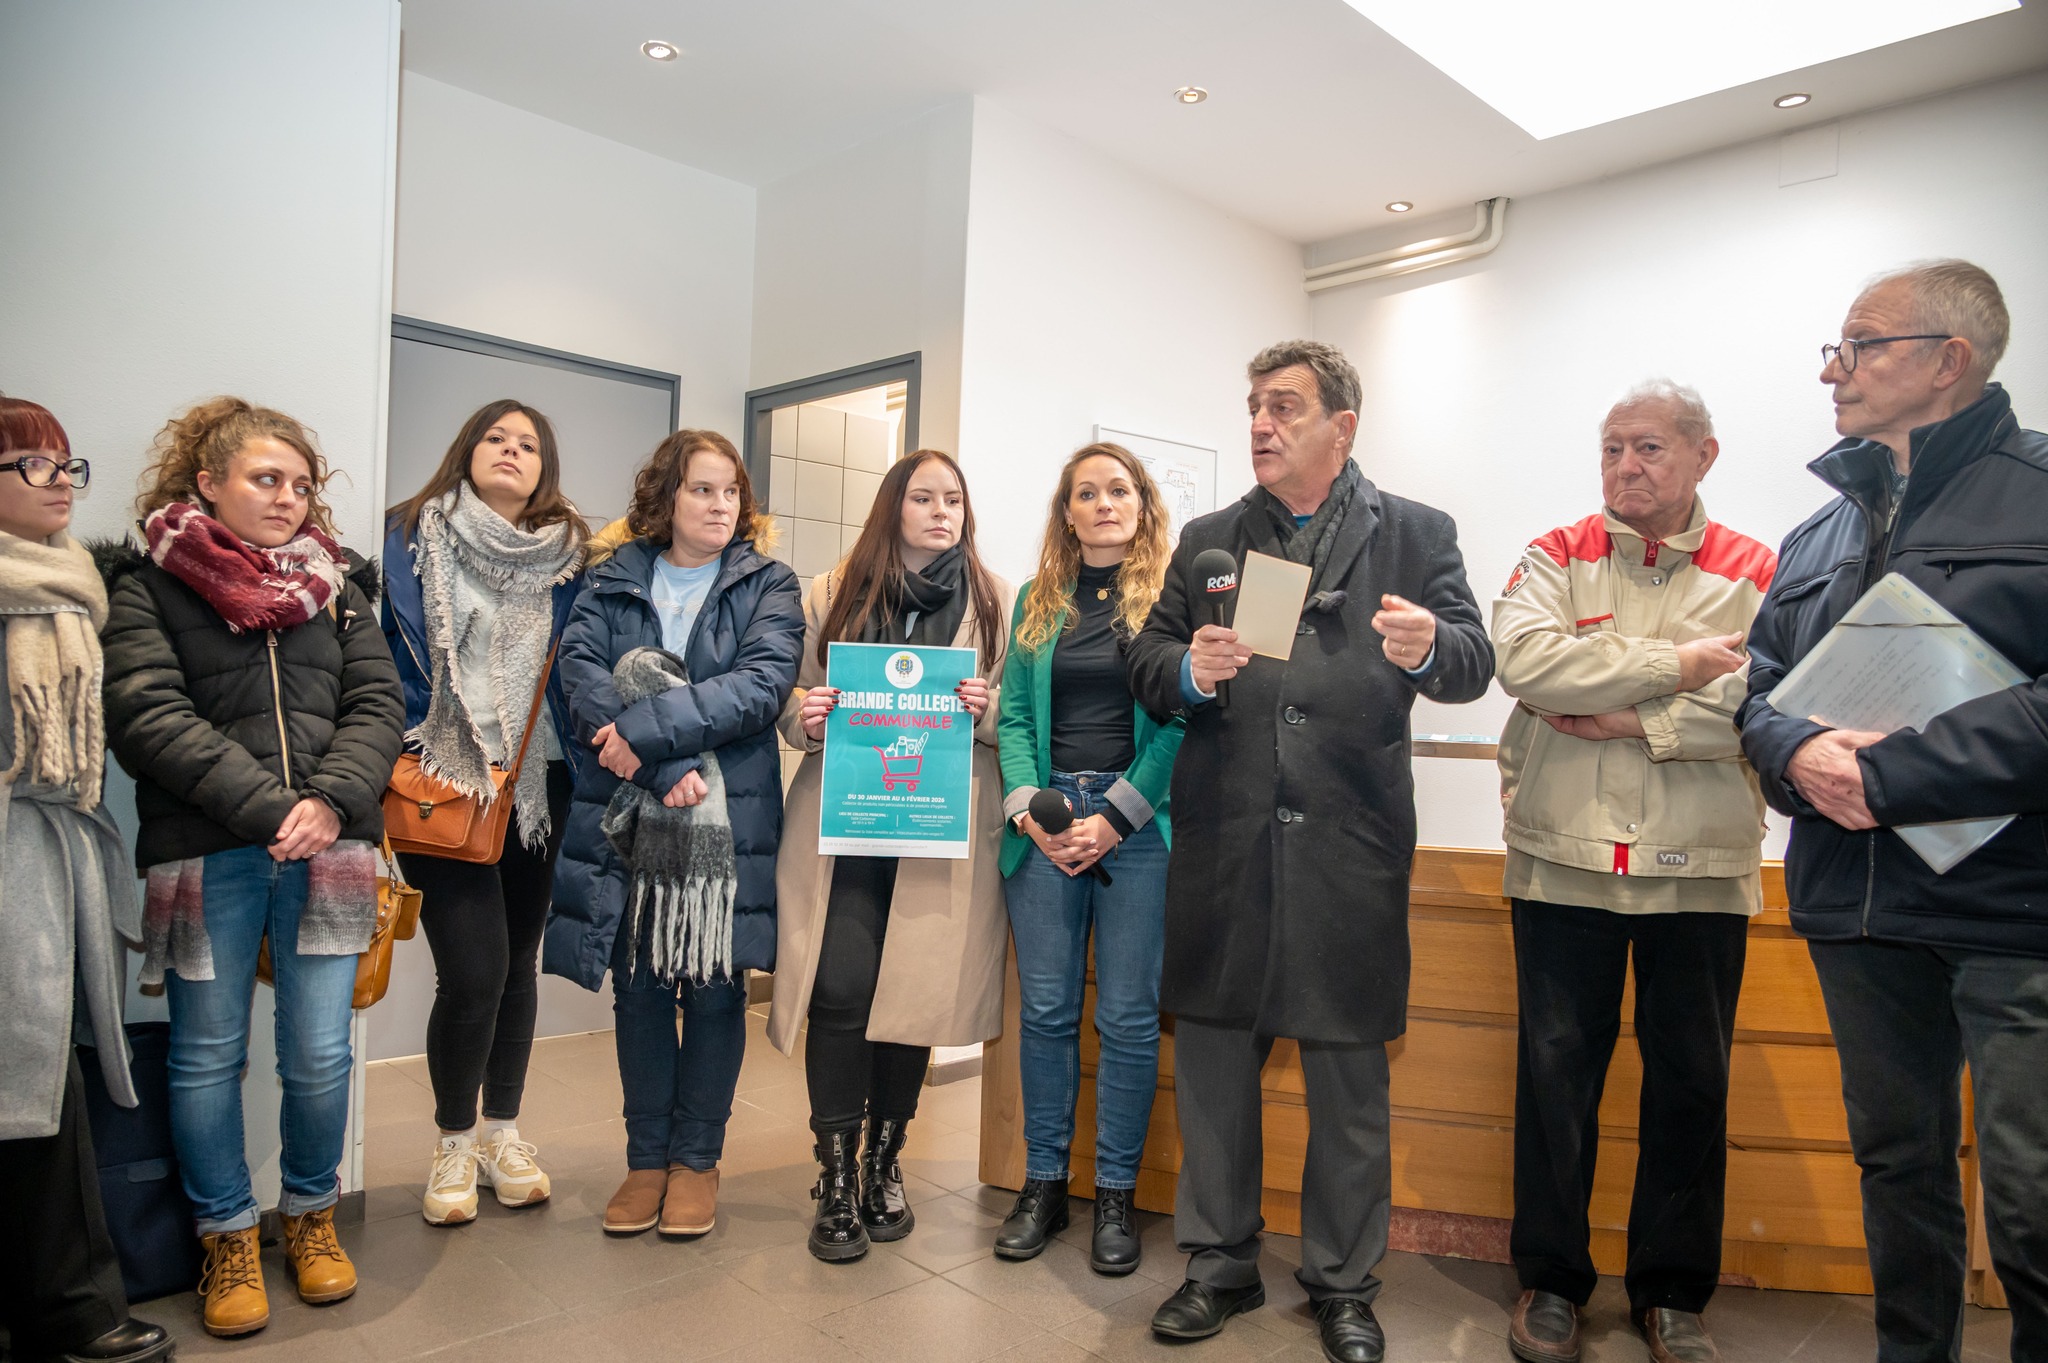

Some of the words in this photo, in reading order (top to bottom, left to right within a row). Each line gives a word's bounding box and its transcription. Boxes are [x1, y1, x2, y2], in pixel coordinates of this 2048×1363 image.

[1207, 572, 1236, 589] RCM
[838, 691, 894, 710] GRANDE
[897, 693, 965, 713] COLLECTE
[848, 712, 953, 730] COMMUNALE
[1660, 853, 1685, 864] VTN
